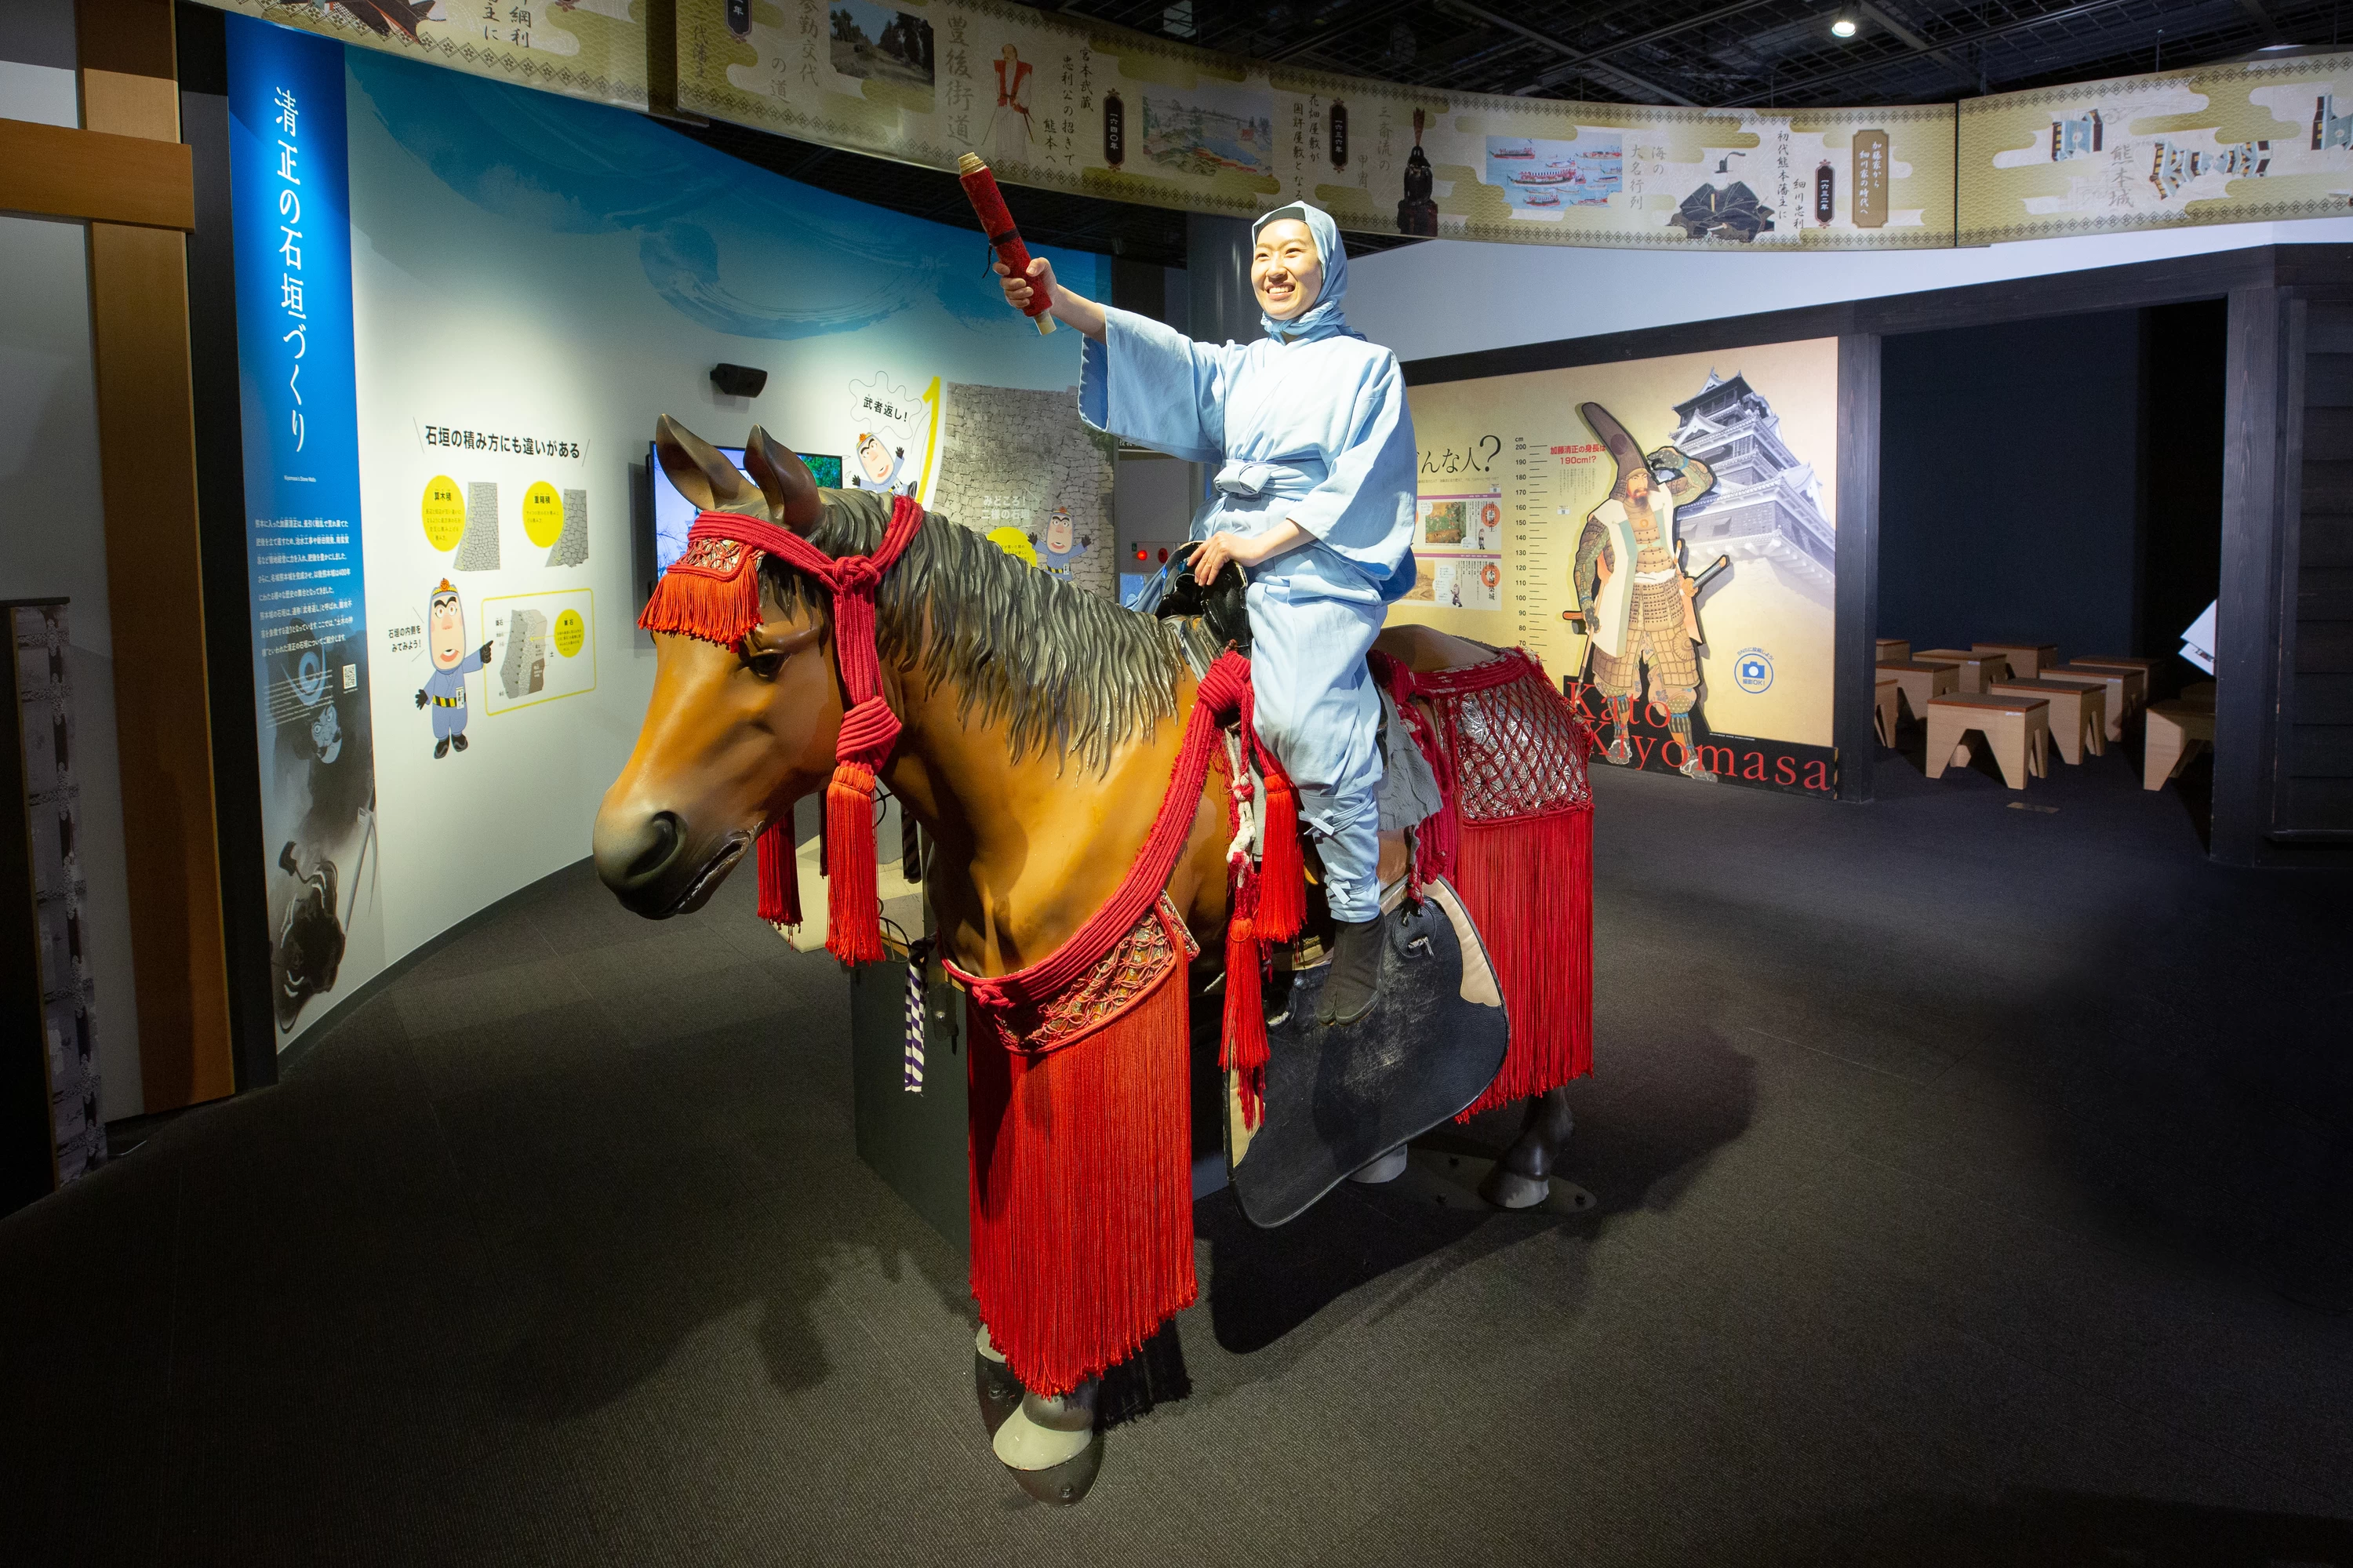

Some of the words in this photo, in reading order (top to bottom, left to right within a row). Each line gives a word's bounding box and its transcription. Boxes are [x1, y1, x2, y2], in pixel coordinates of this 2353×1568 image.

[509, 0, 531, 47] 綱利
[770, 57, 791, 104] の道
[945, 15, 973, 147] 豊後街道
[1079, 47, 1094, 112] 宮本武蔵
[1062, 55, 1076, 166] 忠利公の招きで
[1308, 92, 1322, 163] 花畑屋敷が
[1043, 118, 1057, 163] 熊本へ
[1652, 144, 1667, 176] 海の
[1358, 155, 1369, 189] 甲冑
[1630, 144, 1645, 210] 大名行列
[1777, 130, 1791, 220] 初代熊本藩主に
[1858, 150, 1869, 216] 細川家の時代へ
[1871, 140, 1882, 189] 加藤家から
[2108, 144, 2136, 209] 熊本城
[1792, 178, 1806, 230] 細川忠利
[1820, 179, 1830, 211] 一六三二年
[275, 85, 306, 453] 清正の石垣づくり
[863, 396, 907, 422] 武者返し!
[426, 425, 580, 459] 石垣の積み方にも違いがある
[1417, 435, 1501, 474] んな人?
[1550, 444, 1606, 455] 加藤清正の身長は
[434, 492, 452, 501] 算木積
[534, 495, 551, 504] 重箱積
[981, 509, 1030, 520] 二様の石垣
[388, 625, 421, 638] 石垣の内側を
[1567, 682, 1671, 728] Kato
[1590, 719, 1831, 791] Kiyomasa
